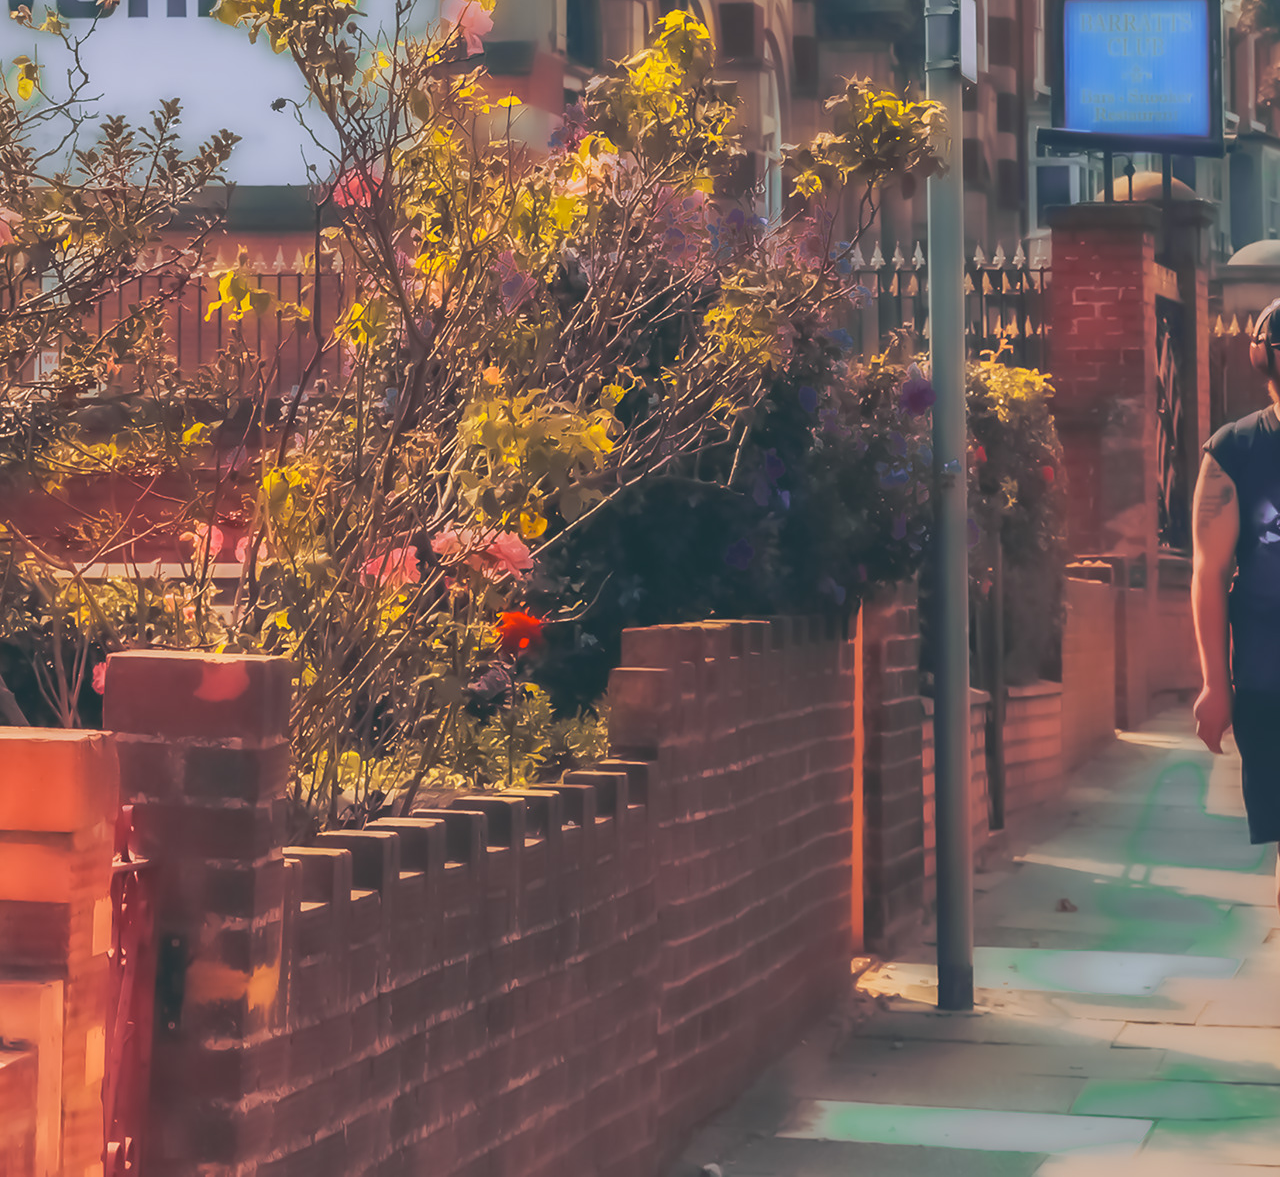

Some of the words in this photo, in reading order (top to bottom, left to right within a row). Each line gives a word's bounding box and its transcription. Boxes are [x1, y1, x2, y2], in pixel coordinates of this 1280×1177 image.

[1080, 13, 1193, 32] BARRATTS
[1107, 37, 1165, 56] CLUB
[1127, 87, 1193, 104] Snooker
[1094, 105, 1179, 122] Restaurant
